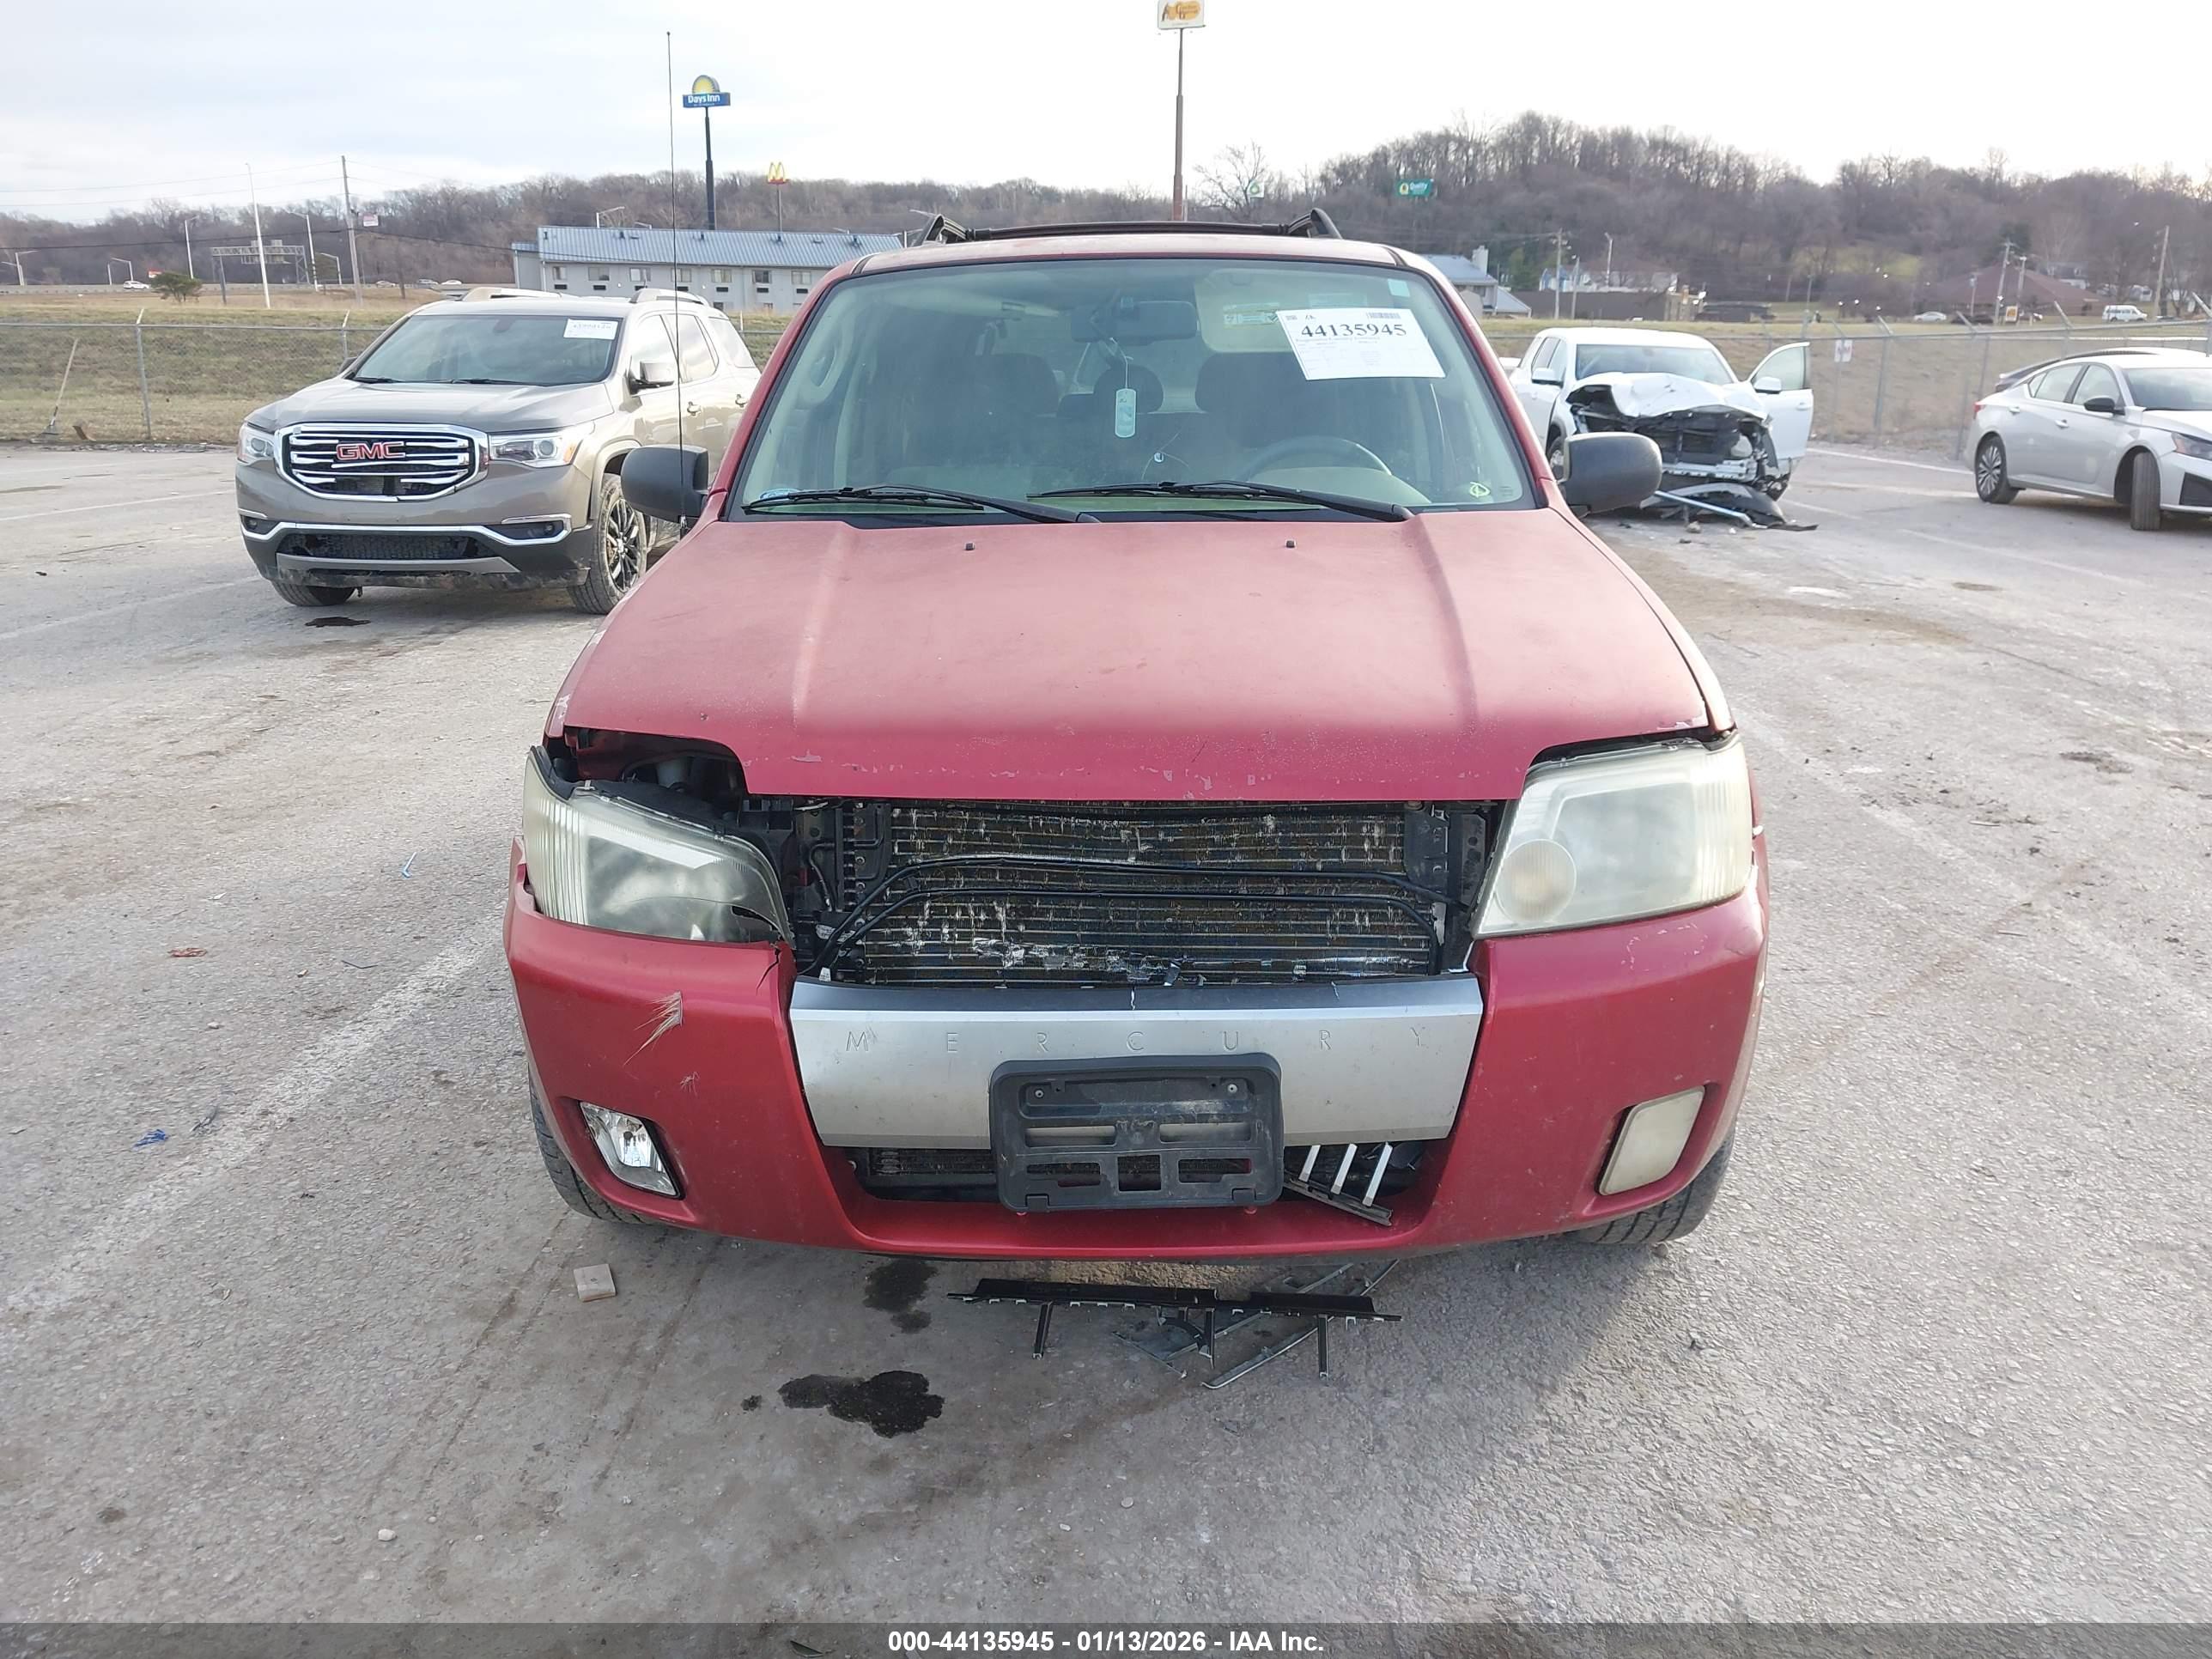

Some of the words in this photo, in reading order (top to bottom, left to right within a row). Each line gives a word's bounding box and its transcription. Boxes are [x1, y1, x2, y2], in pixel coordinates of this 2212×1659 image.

[688, 95, 706, 104] Days
[708, 94, 720, 102] Inn
[1301, 323, 1407, 337] 44135945
[336, 441, 406, 460] GMC
[846, 1027, 1425, 1052] MERCURY
